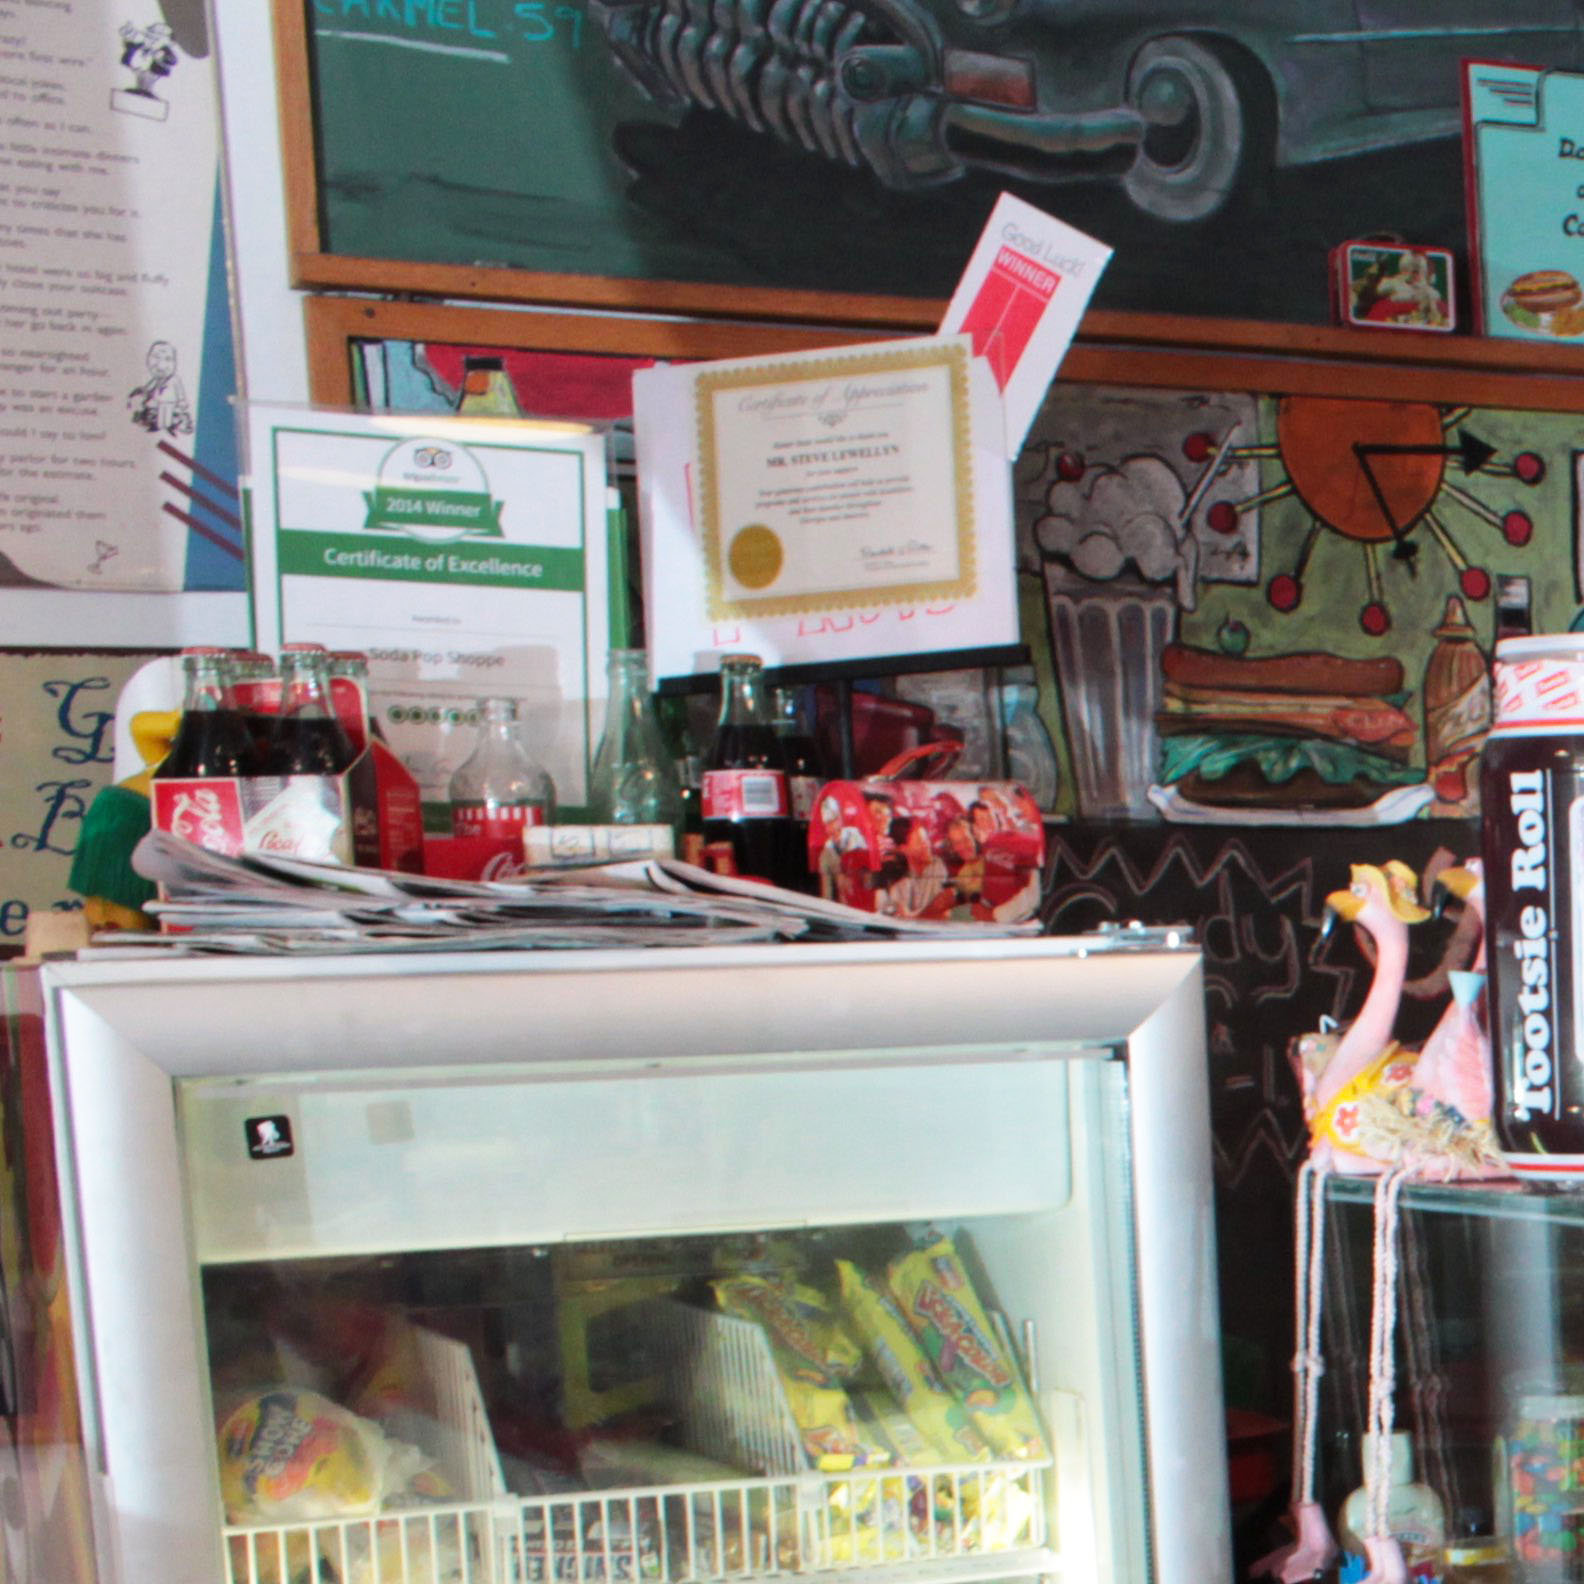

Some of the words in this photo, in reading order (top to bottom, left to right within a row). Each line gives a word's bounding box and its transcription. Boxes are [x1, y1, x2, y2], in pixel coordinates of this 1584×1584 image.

[997, 248, 1058, 293] WINNER
[386, 498, 424, 515] 2014
[425, 499, 481, 518] Winner
[323, 547, 422, 573] Certificate
[425, 552, 446, 572] of
[447, 555, 544, 578] Excellence
[368, 648, 411, 664] Soda
[413, 650, 443, 668] Pop
[447, 652, 505, 668] Shoppe
[1508, 766, 1547, 894] Roll
[1514, 904, 1555, 1124] Tootsie
